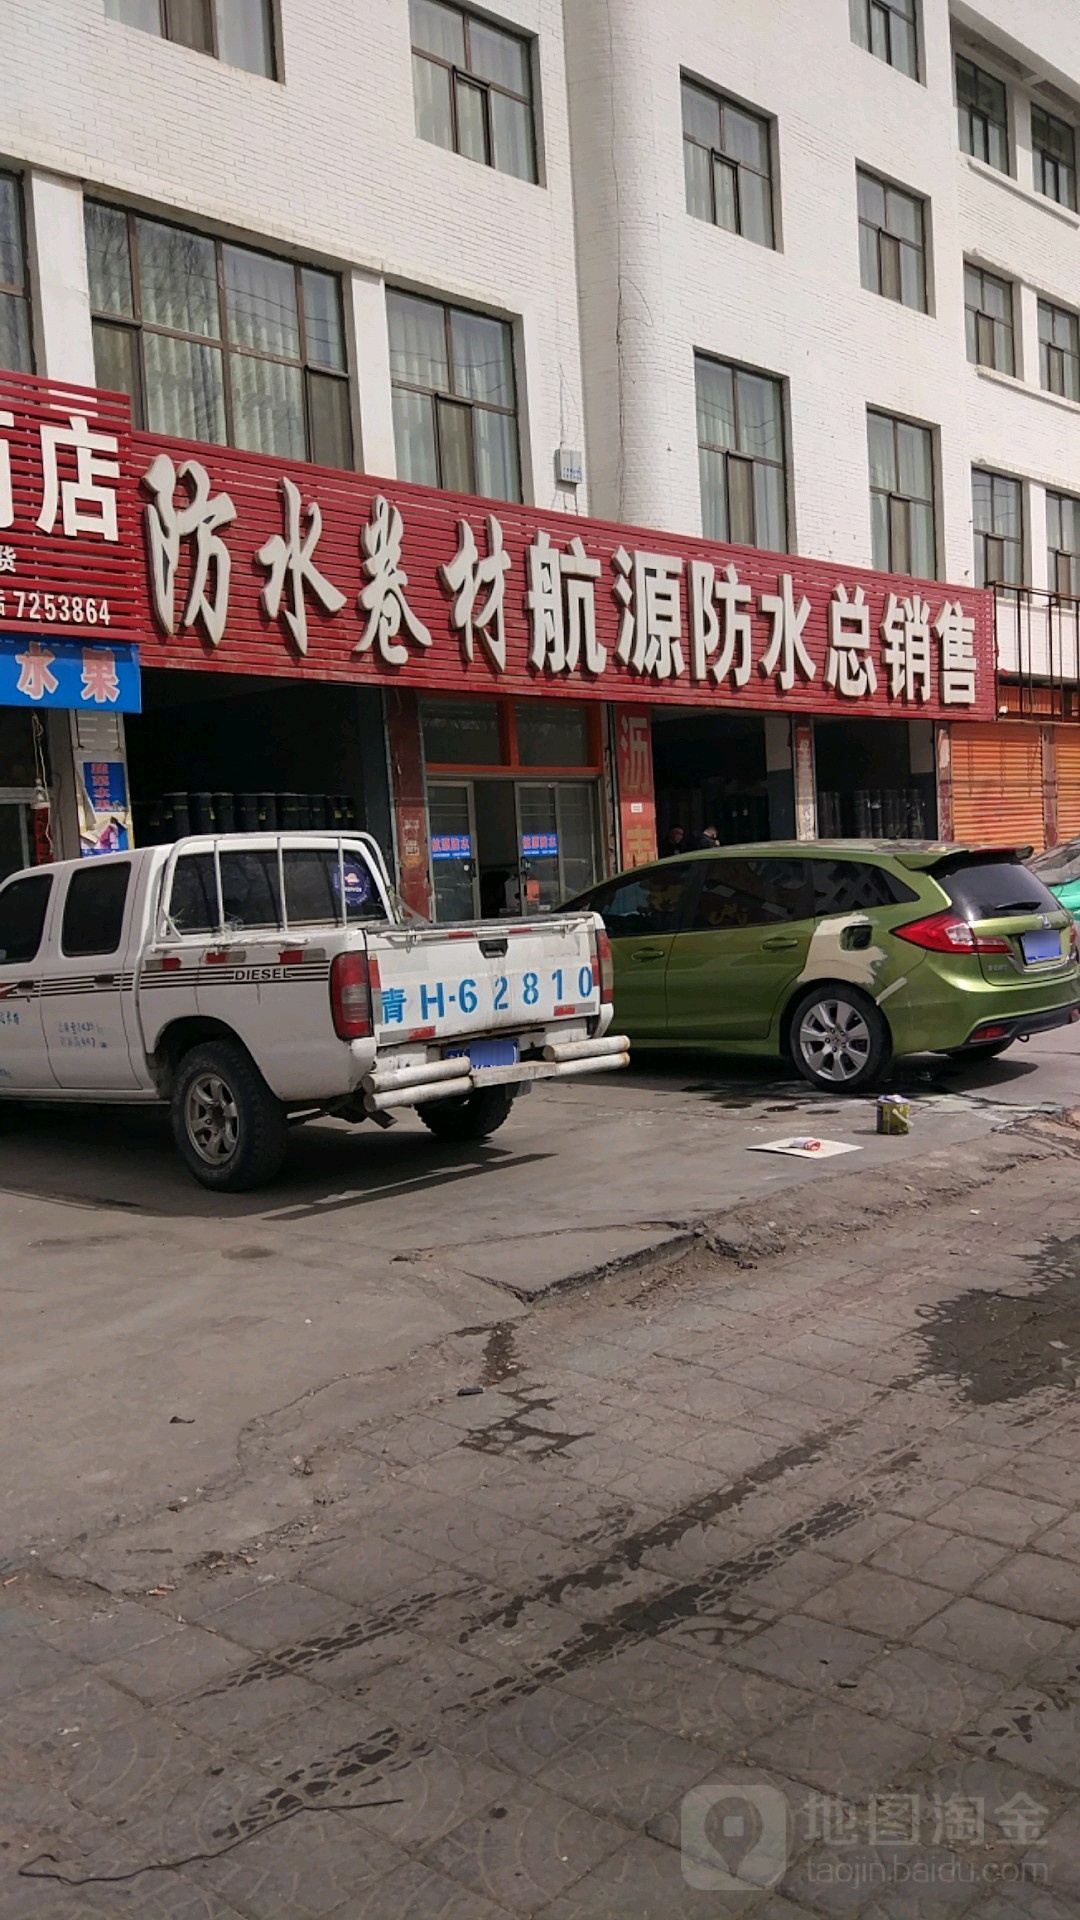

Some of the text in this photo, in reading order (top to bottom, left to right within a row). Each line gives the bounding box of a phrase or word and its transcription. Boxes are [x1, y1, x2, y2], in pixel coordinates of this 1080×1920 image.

[0, 411, 120, 541] 店
[15, 645, 121, 702] 水果
[235, 967, 293, 981] DIESEL
